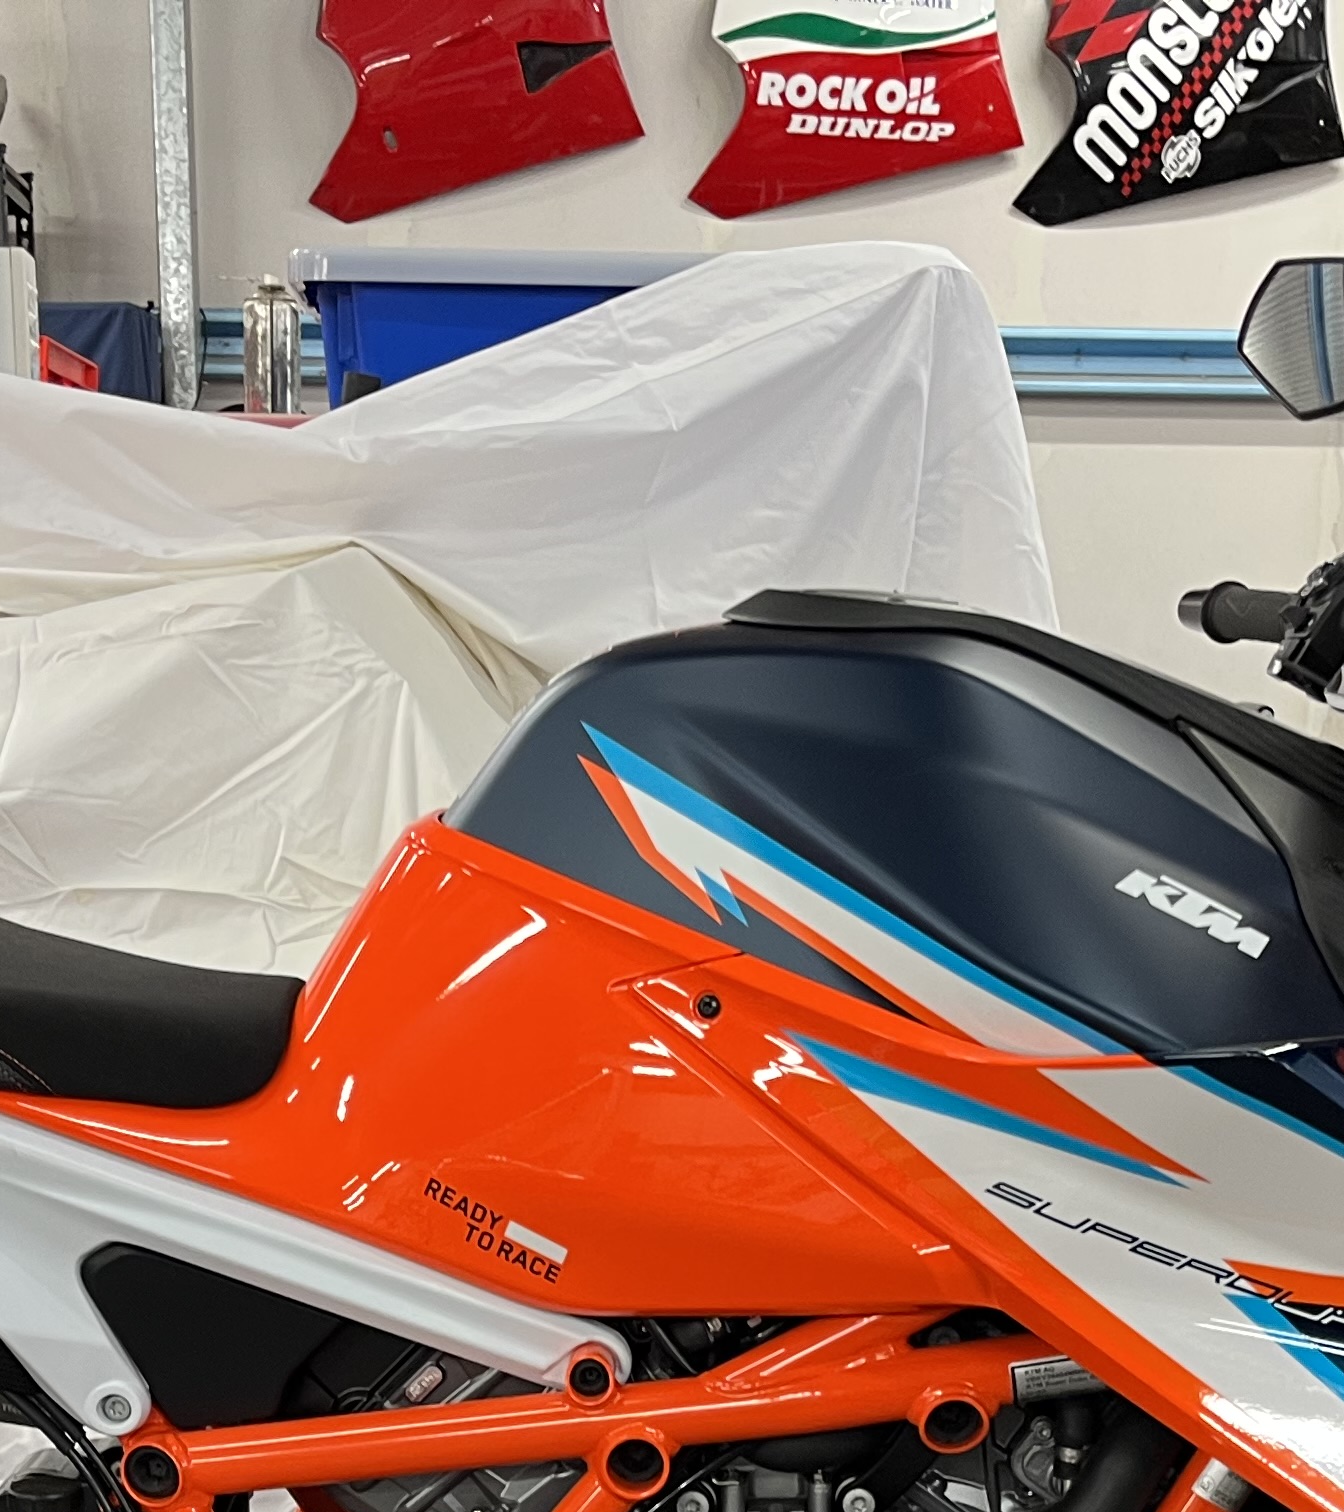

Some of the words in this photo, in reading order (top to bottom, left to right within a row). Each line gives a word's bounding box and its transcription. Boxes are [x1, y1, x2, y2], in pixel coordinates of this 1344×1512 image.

[756, 71, 873, 112] ROCK
[875, 76, 941, 116] OIL
[785, 113, 956, 142] DUNLOP
[1114, 868, 1270, 960] KTM
[424, 1177, 504, 1230] READY
[465, 1222, 495, 1252] TO
[496, 1239, 561, 1285] RACE
